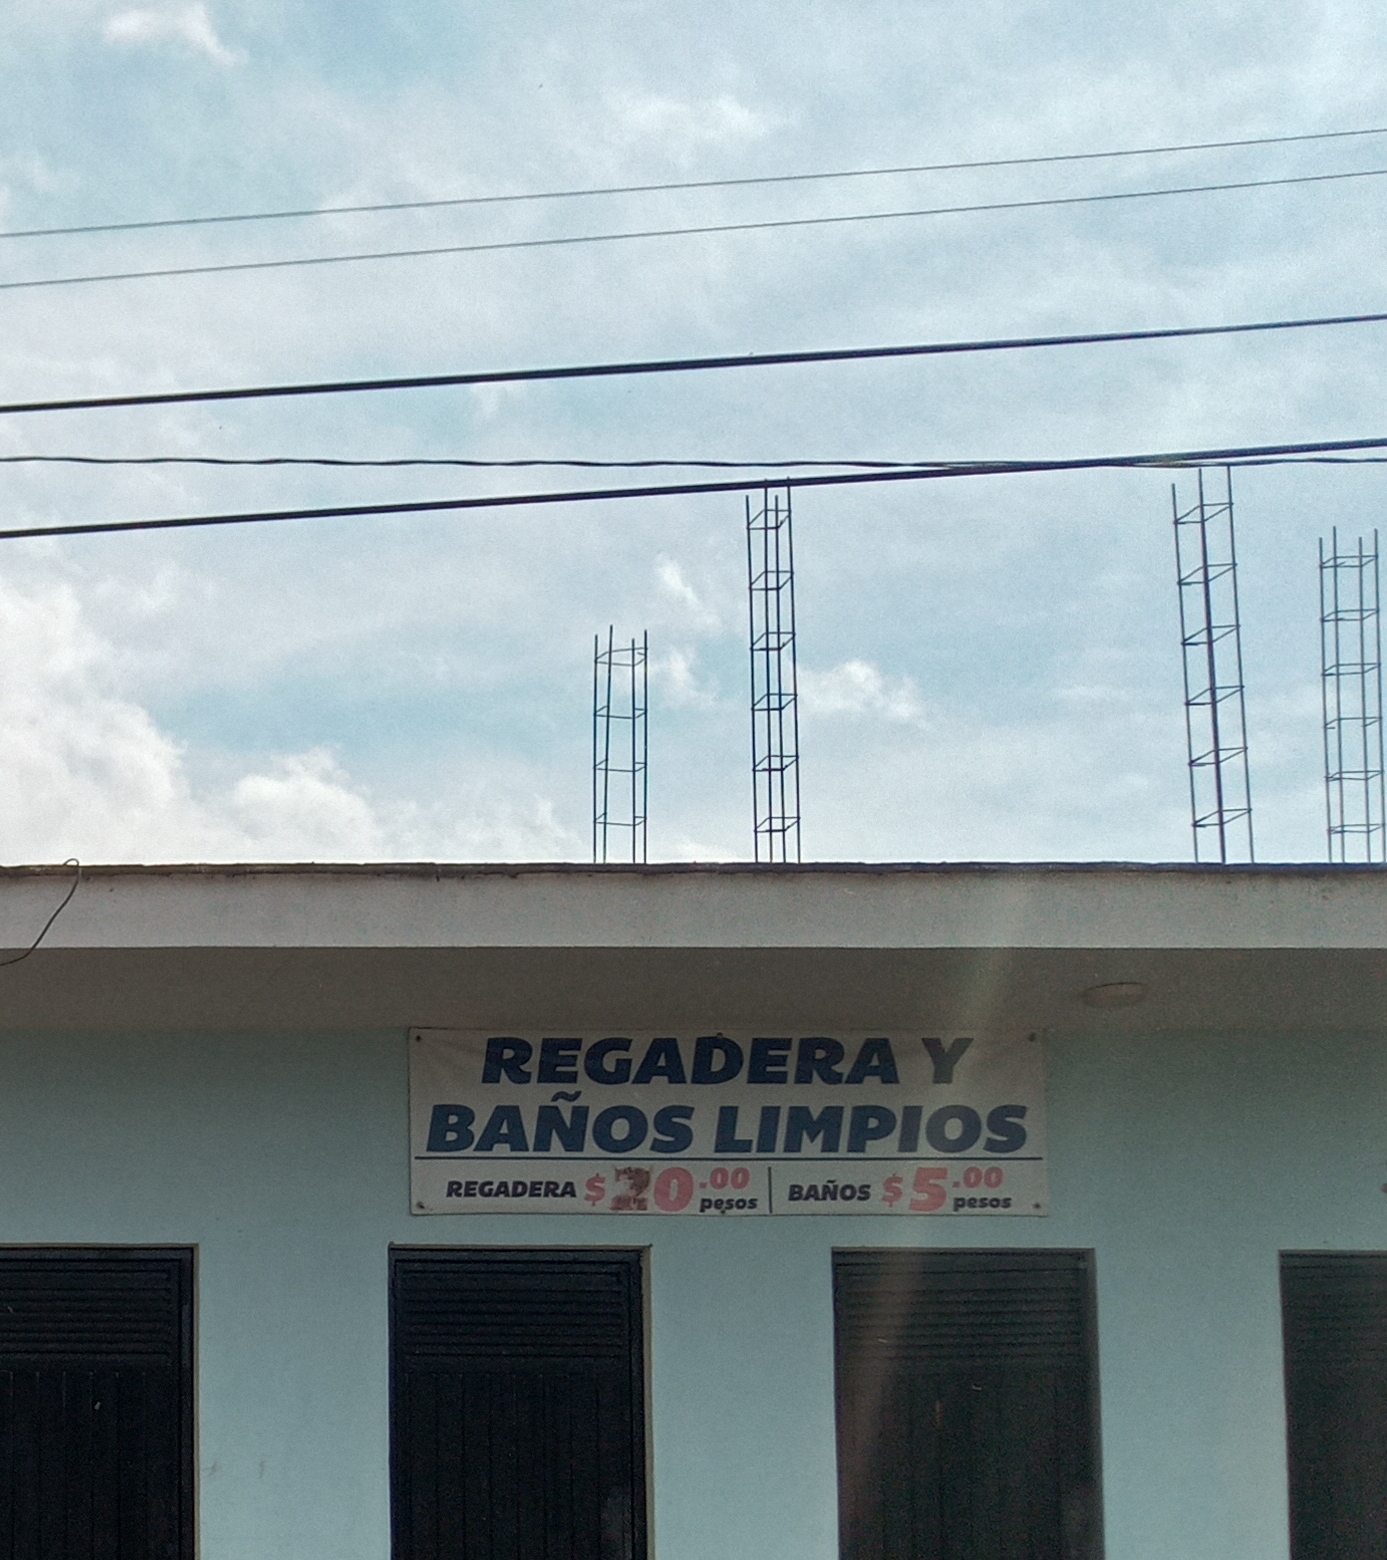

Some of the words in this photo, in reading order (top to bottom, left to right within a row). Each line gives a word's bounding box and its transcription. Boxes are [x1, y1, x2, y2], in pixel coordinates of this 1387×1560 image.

[481, 1036, 901, 1086] REGADERA
[921, 1037, 975, 1086] Y
[425, 1091, 696, 1154] BAÑOS
[713, 1104, 1029, 1154] LIMPIOS
[446, 1179, 577, 1199] REGADERA
[787, 1179, 872, 1202] BAÑOS
[699, 1195, 758, 1213] pesos
[953, 1195, 1012, 1212] pesos
